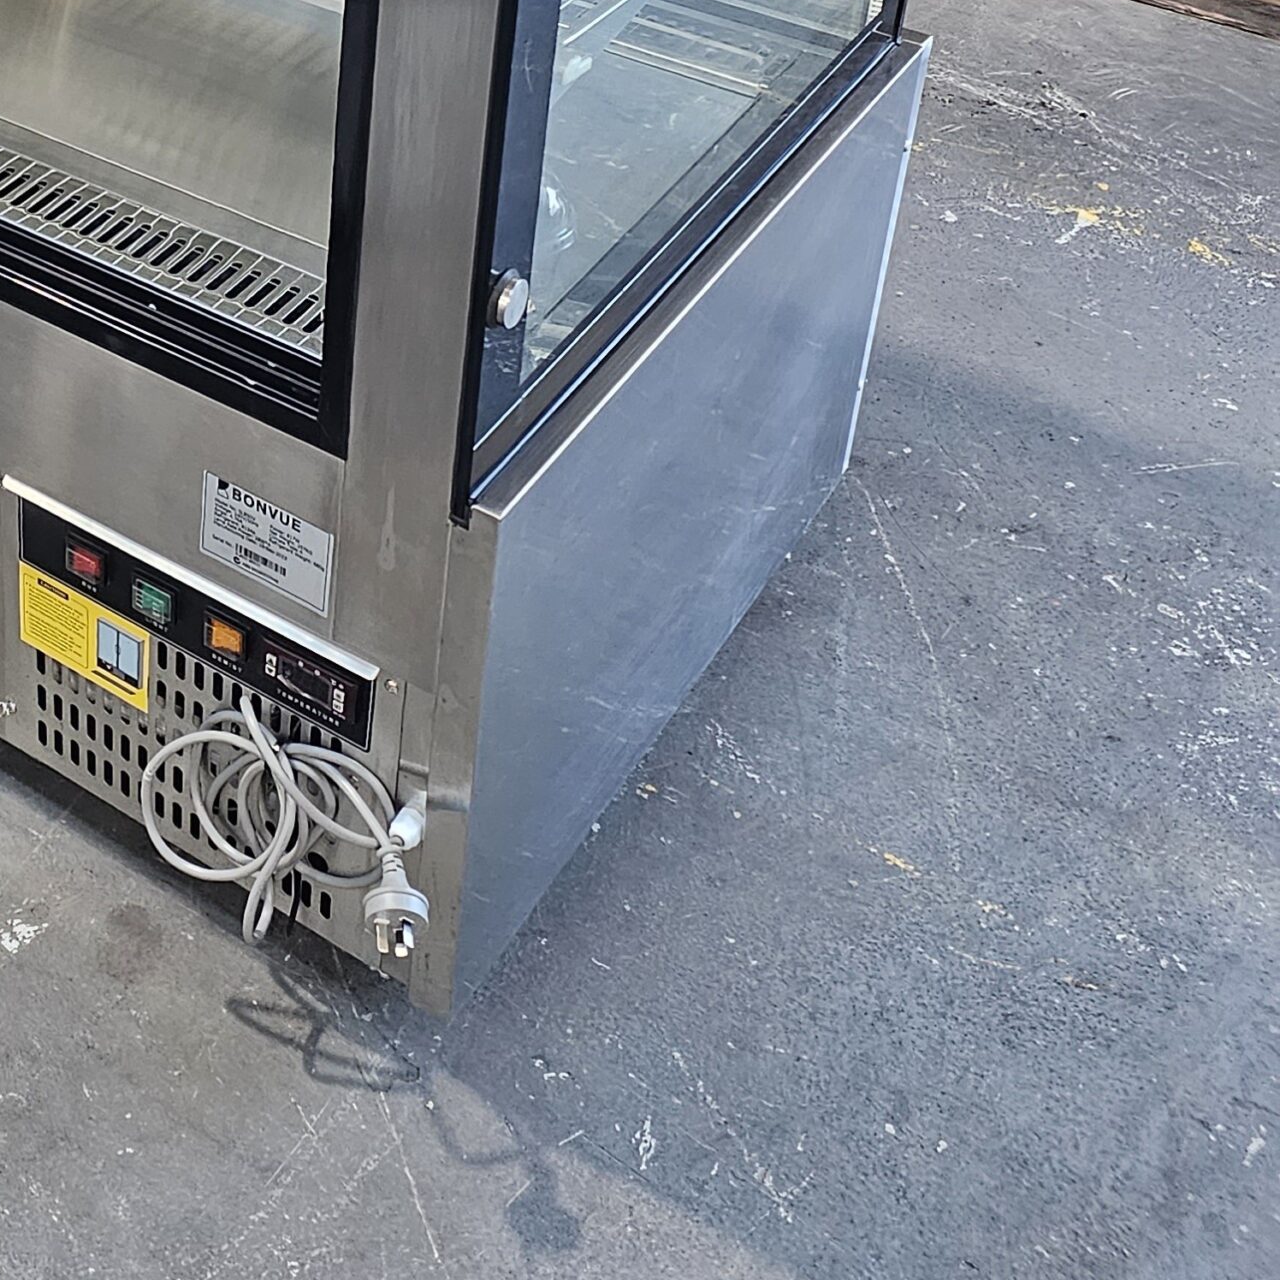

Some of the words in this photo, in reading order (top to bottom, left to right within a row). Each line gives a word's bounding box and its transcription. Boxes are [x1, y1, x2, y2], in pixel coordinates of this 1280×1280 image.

[231, 487, 302, 533] BONVUE
[211, 652, 243, 673] DEMIST
[276, 687, 340, 727] TEMPERATURE
